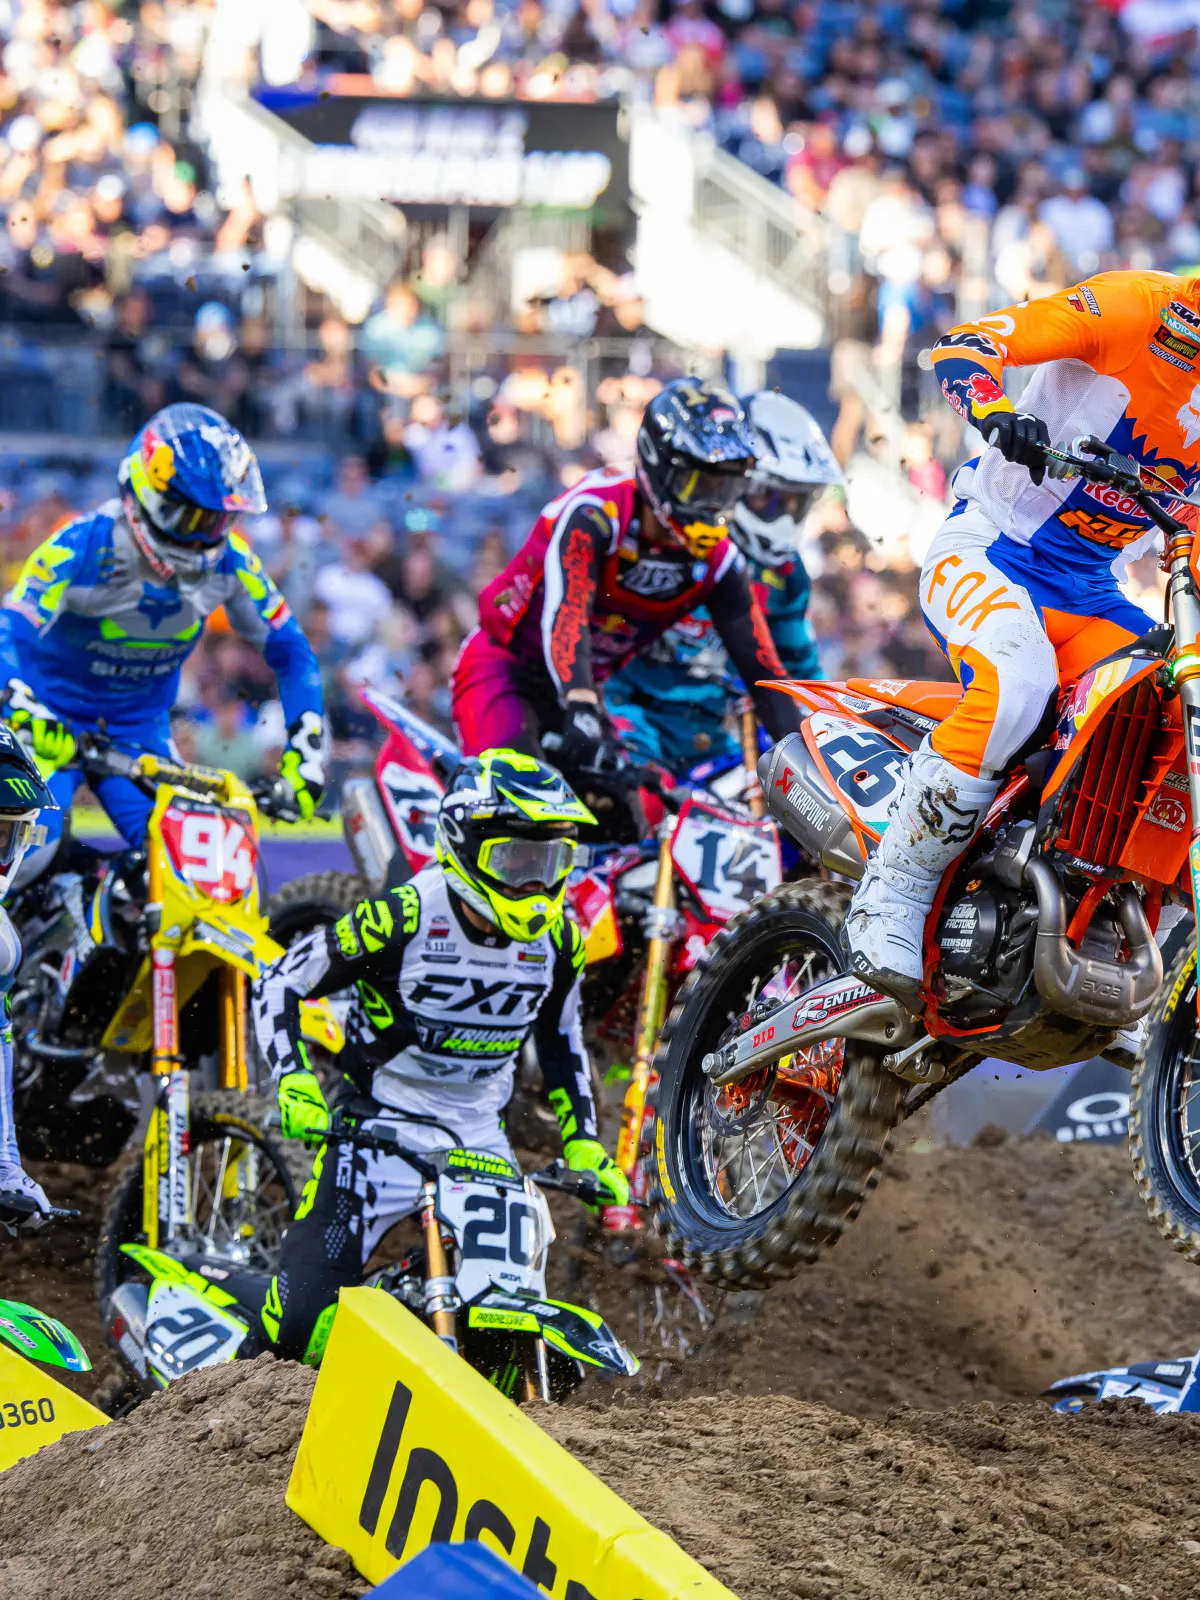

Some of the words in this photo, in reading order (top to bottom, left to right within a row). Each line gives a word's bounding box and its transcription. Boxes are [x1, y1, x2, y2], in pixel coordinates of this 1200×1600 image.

[1148, 342, 1195, 373] PROGRESSIVE
[1058, 509, 1149, 550] KTM
[927, 554, 1023, 632] FOX
[817, 732, 910, 808] 26
[786, 783, 831, 832] AKRAPOVIČ
[181, 815, 253, 890] 94
[696, 831, 768, 898] 14
[1071, 858, 1091, 870] Twin
[945, 918, 977, 929] FACTORY
[950, 903, 977, 918] KTM
[940, 938, 973, 947] HINSON
[854, 955, 875, 976] FOX
[794, 985, 880, 1029] RENTHA
[441, 1037, 522, 1053] RACING
[753, 1026, 775, 1048] DID
[462, 1194, 542, 1267] 20
[146, 1307, 232, 1374] 20
[0, 1398, 55, 1430] 360
